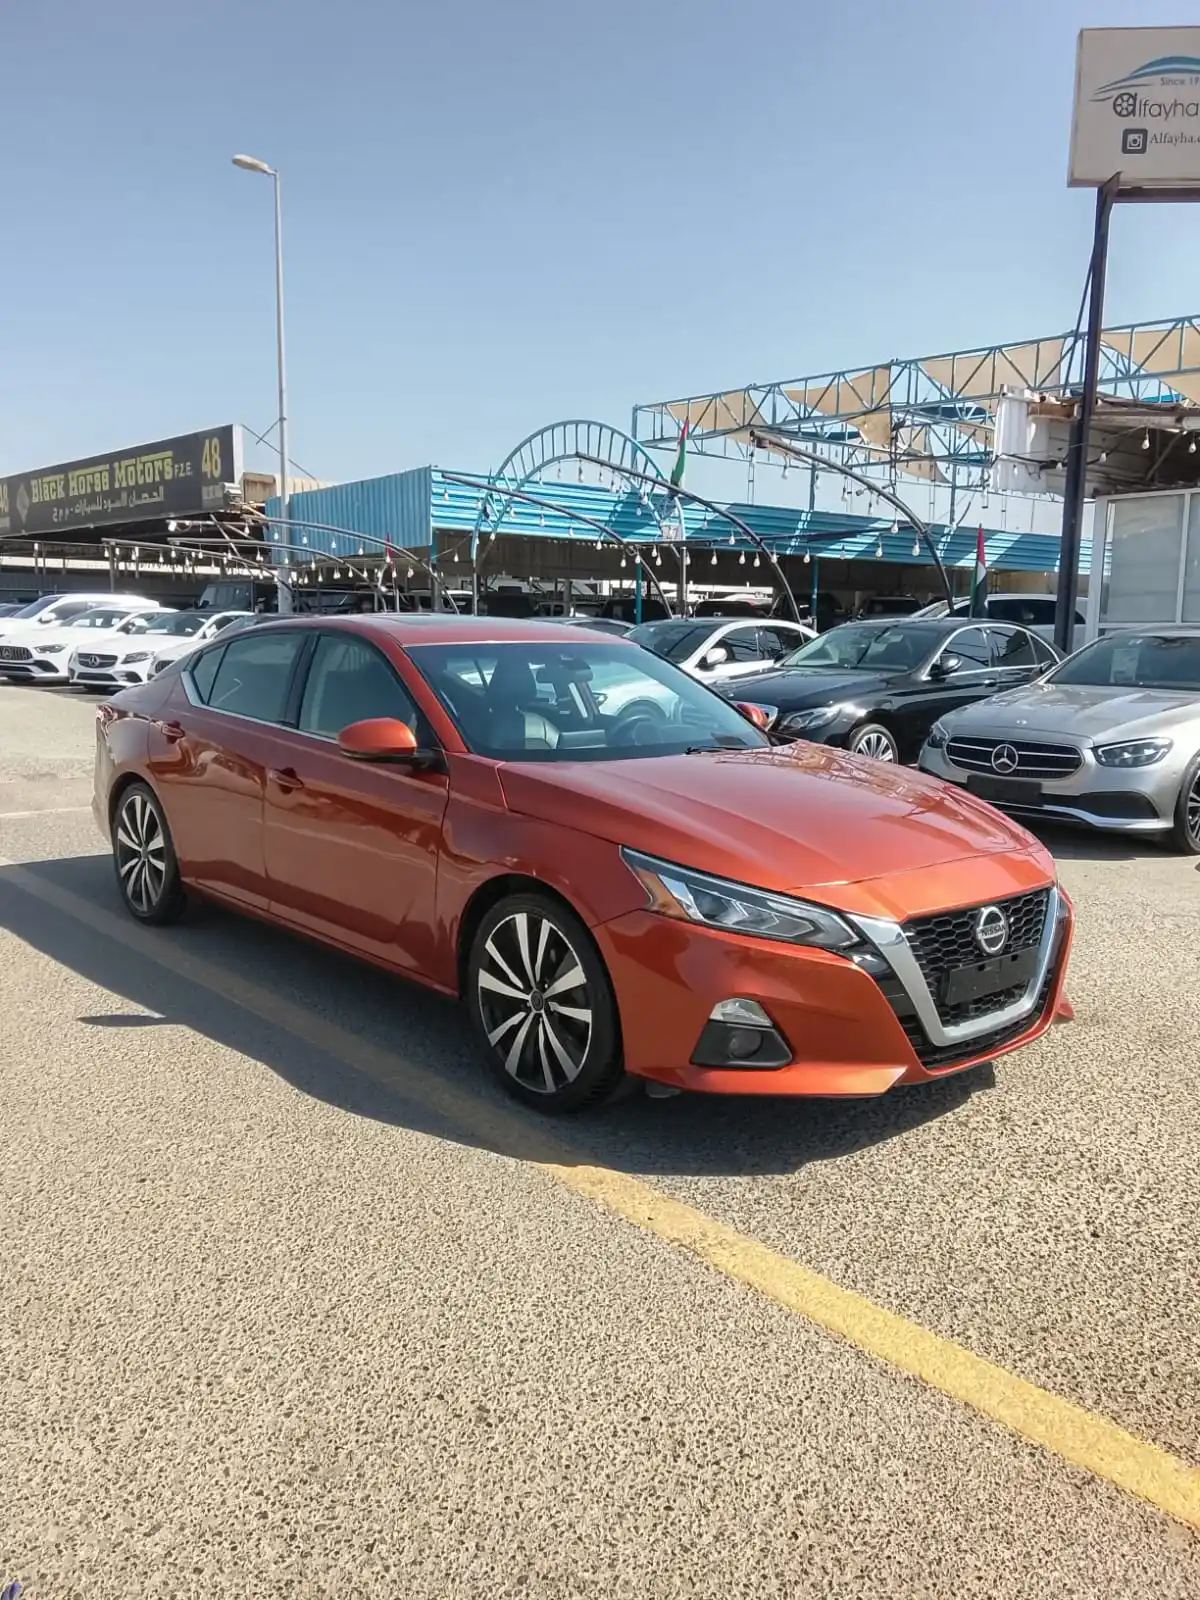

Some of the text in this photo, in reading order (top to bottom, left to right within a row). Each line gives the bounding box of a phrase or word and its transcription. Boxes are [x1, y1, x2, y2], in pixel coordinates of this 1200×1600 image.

[1160, 76, 1200, 86] Since 19
[201, 436, 222, 480] 48
[30, 474, 66, 504] Black
[68, 463, 110, 497] Horse
[113, 450, 174, 489] Motors
[980, 924, 1006, 937] NISSAN
